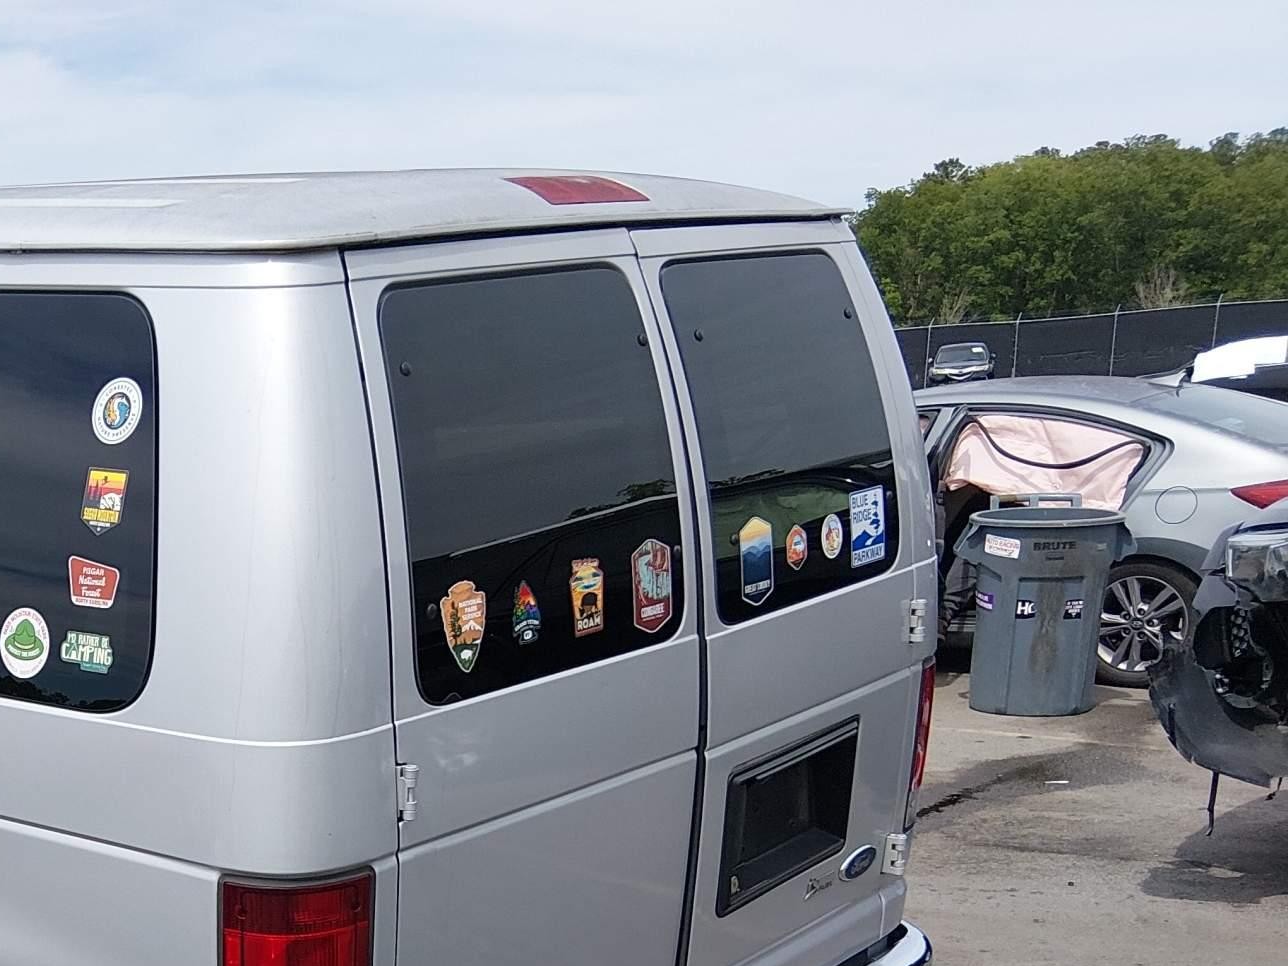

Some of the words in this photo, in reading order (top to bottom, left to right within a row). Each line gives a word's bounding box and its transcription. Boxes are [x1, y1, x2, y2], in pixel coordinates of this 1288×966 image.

[852, 494, 869, 510] BLUE
[852, 508, 872, 524] RIDGE
[853, 545, 884, 564] PARKWAY
[1033, 541, 1077, 552] BRUTE
[577, 615, 602, 632] ROAM
[61, 641, 113, 666] CAMPING
